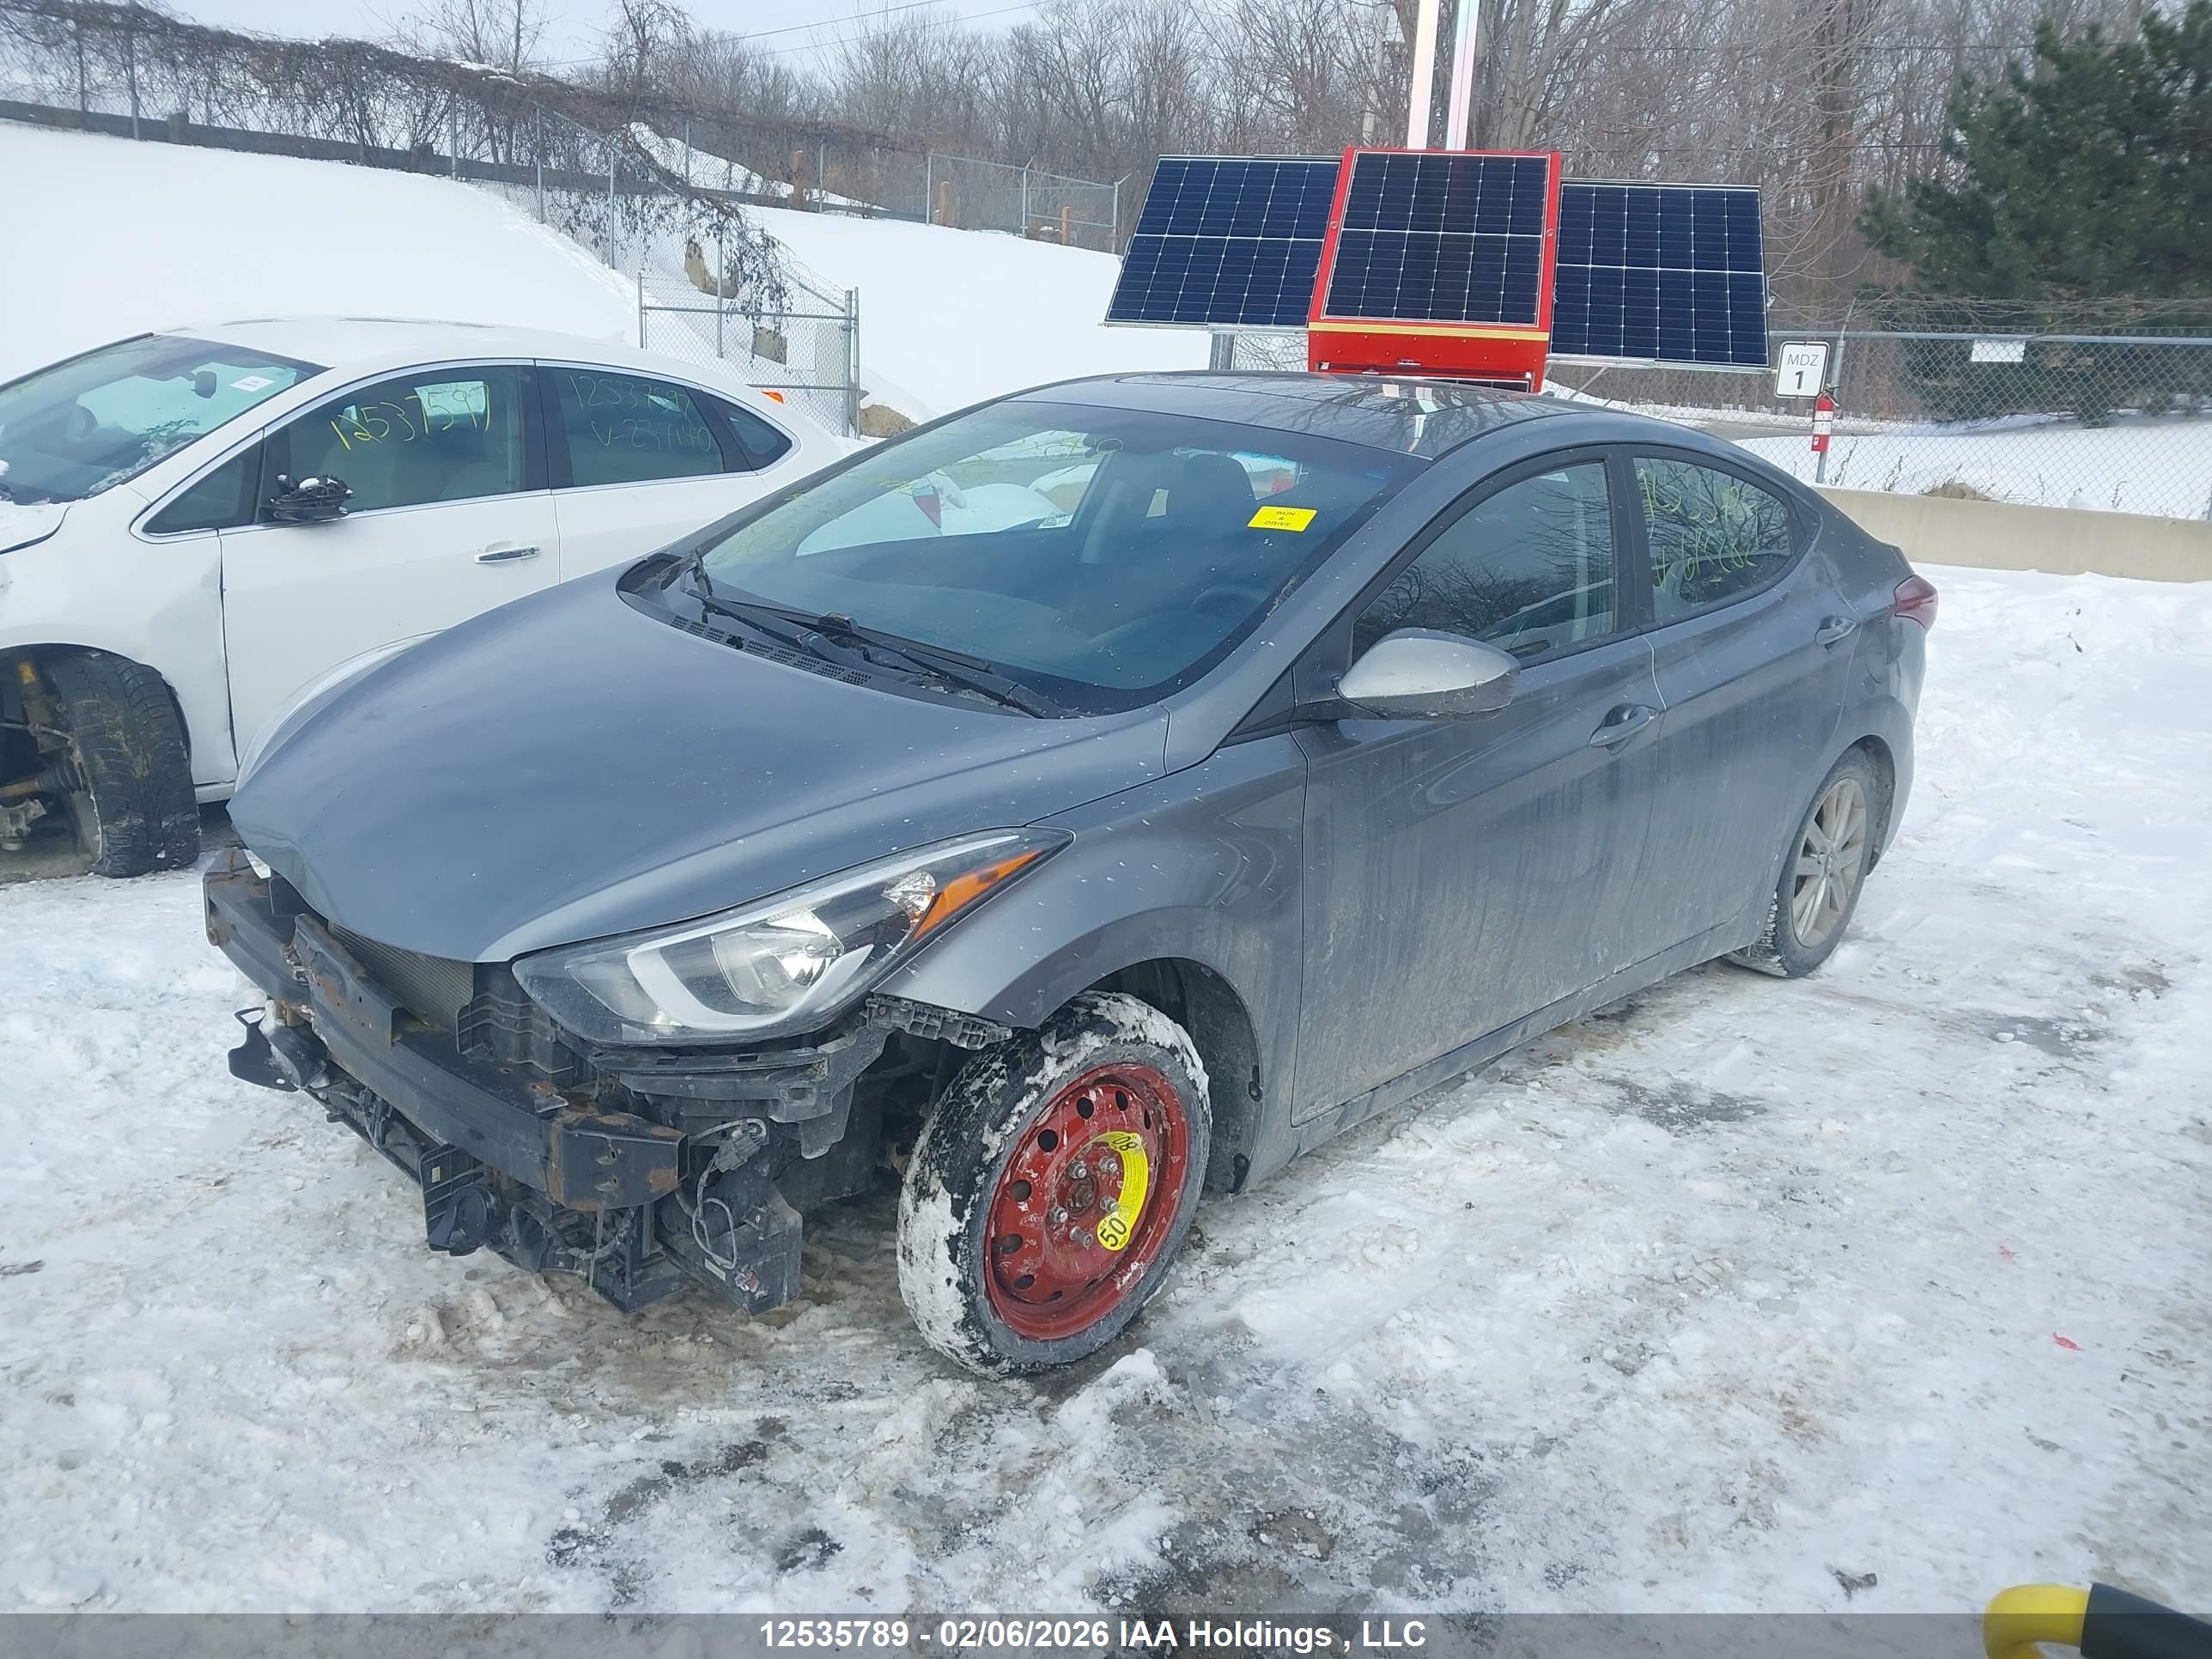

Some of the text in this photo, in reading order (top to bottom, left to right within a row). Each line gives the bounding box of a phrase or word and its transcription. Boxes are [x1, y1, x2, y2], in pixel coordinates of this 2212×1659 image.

[1787, 353, 1820, 367] MDZ
[1795, 370, 1805, 390] 1
[1100, 1218, 1127, 1247] 50
